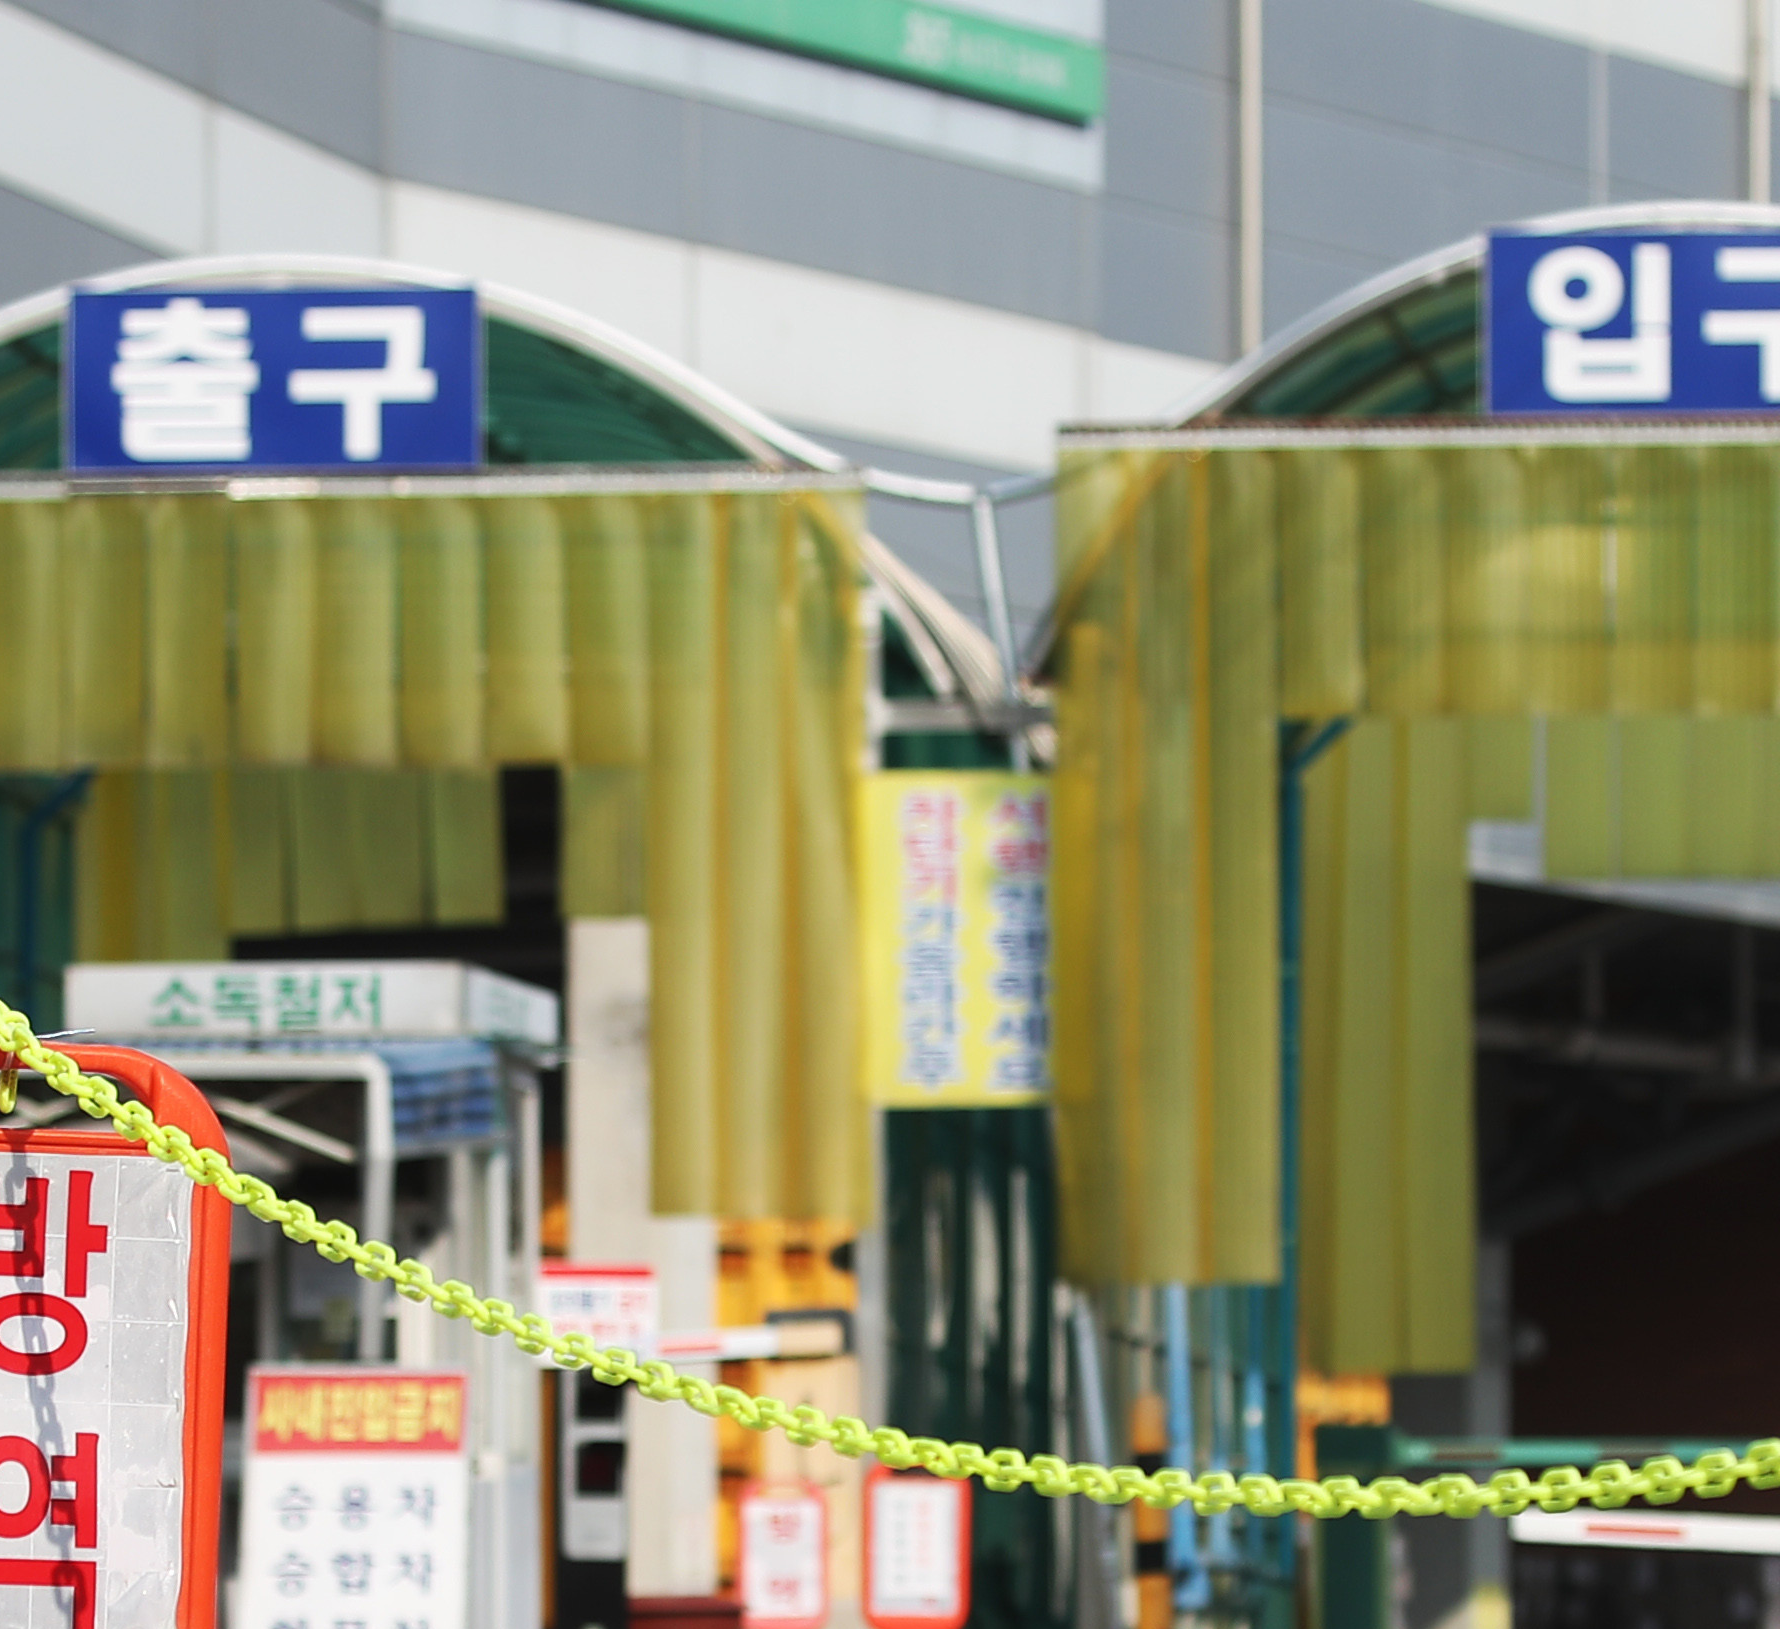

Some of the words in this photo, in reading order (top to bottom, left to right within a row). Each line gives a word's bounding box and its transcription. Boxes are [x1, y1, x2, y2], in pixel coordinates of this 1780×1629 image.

[110, 296, 438, 462] 출구
[150, 971, 382, 1028] 소독철저
[273, 1483, 437, 1531] 승용차
[273, 1549, 435, 1595] 승합차
